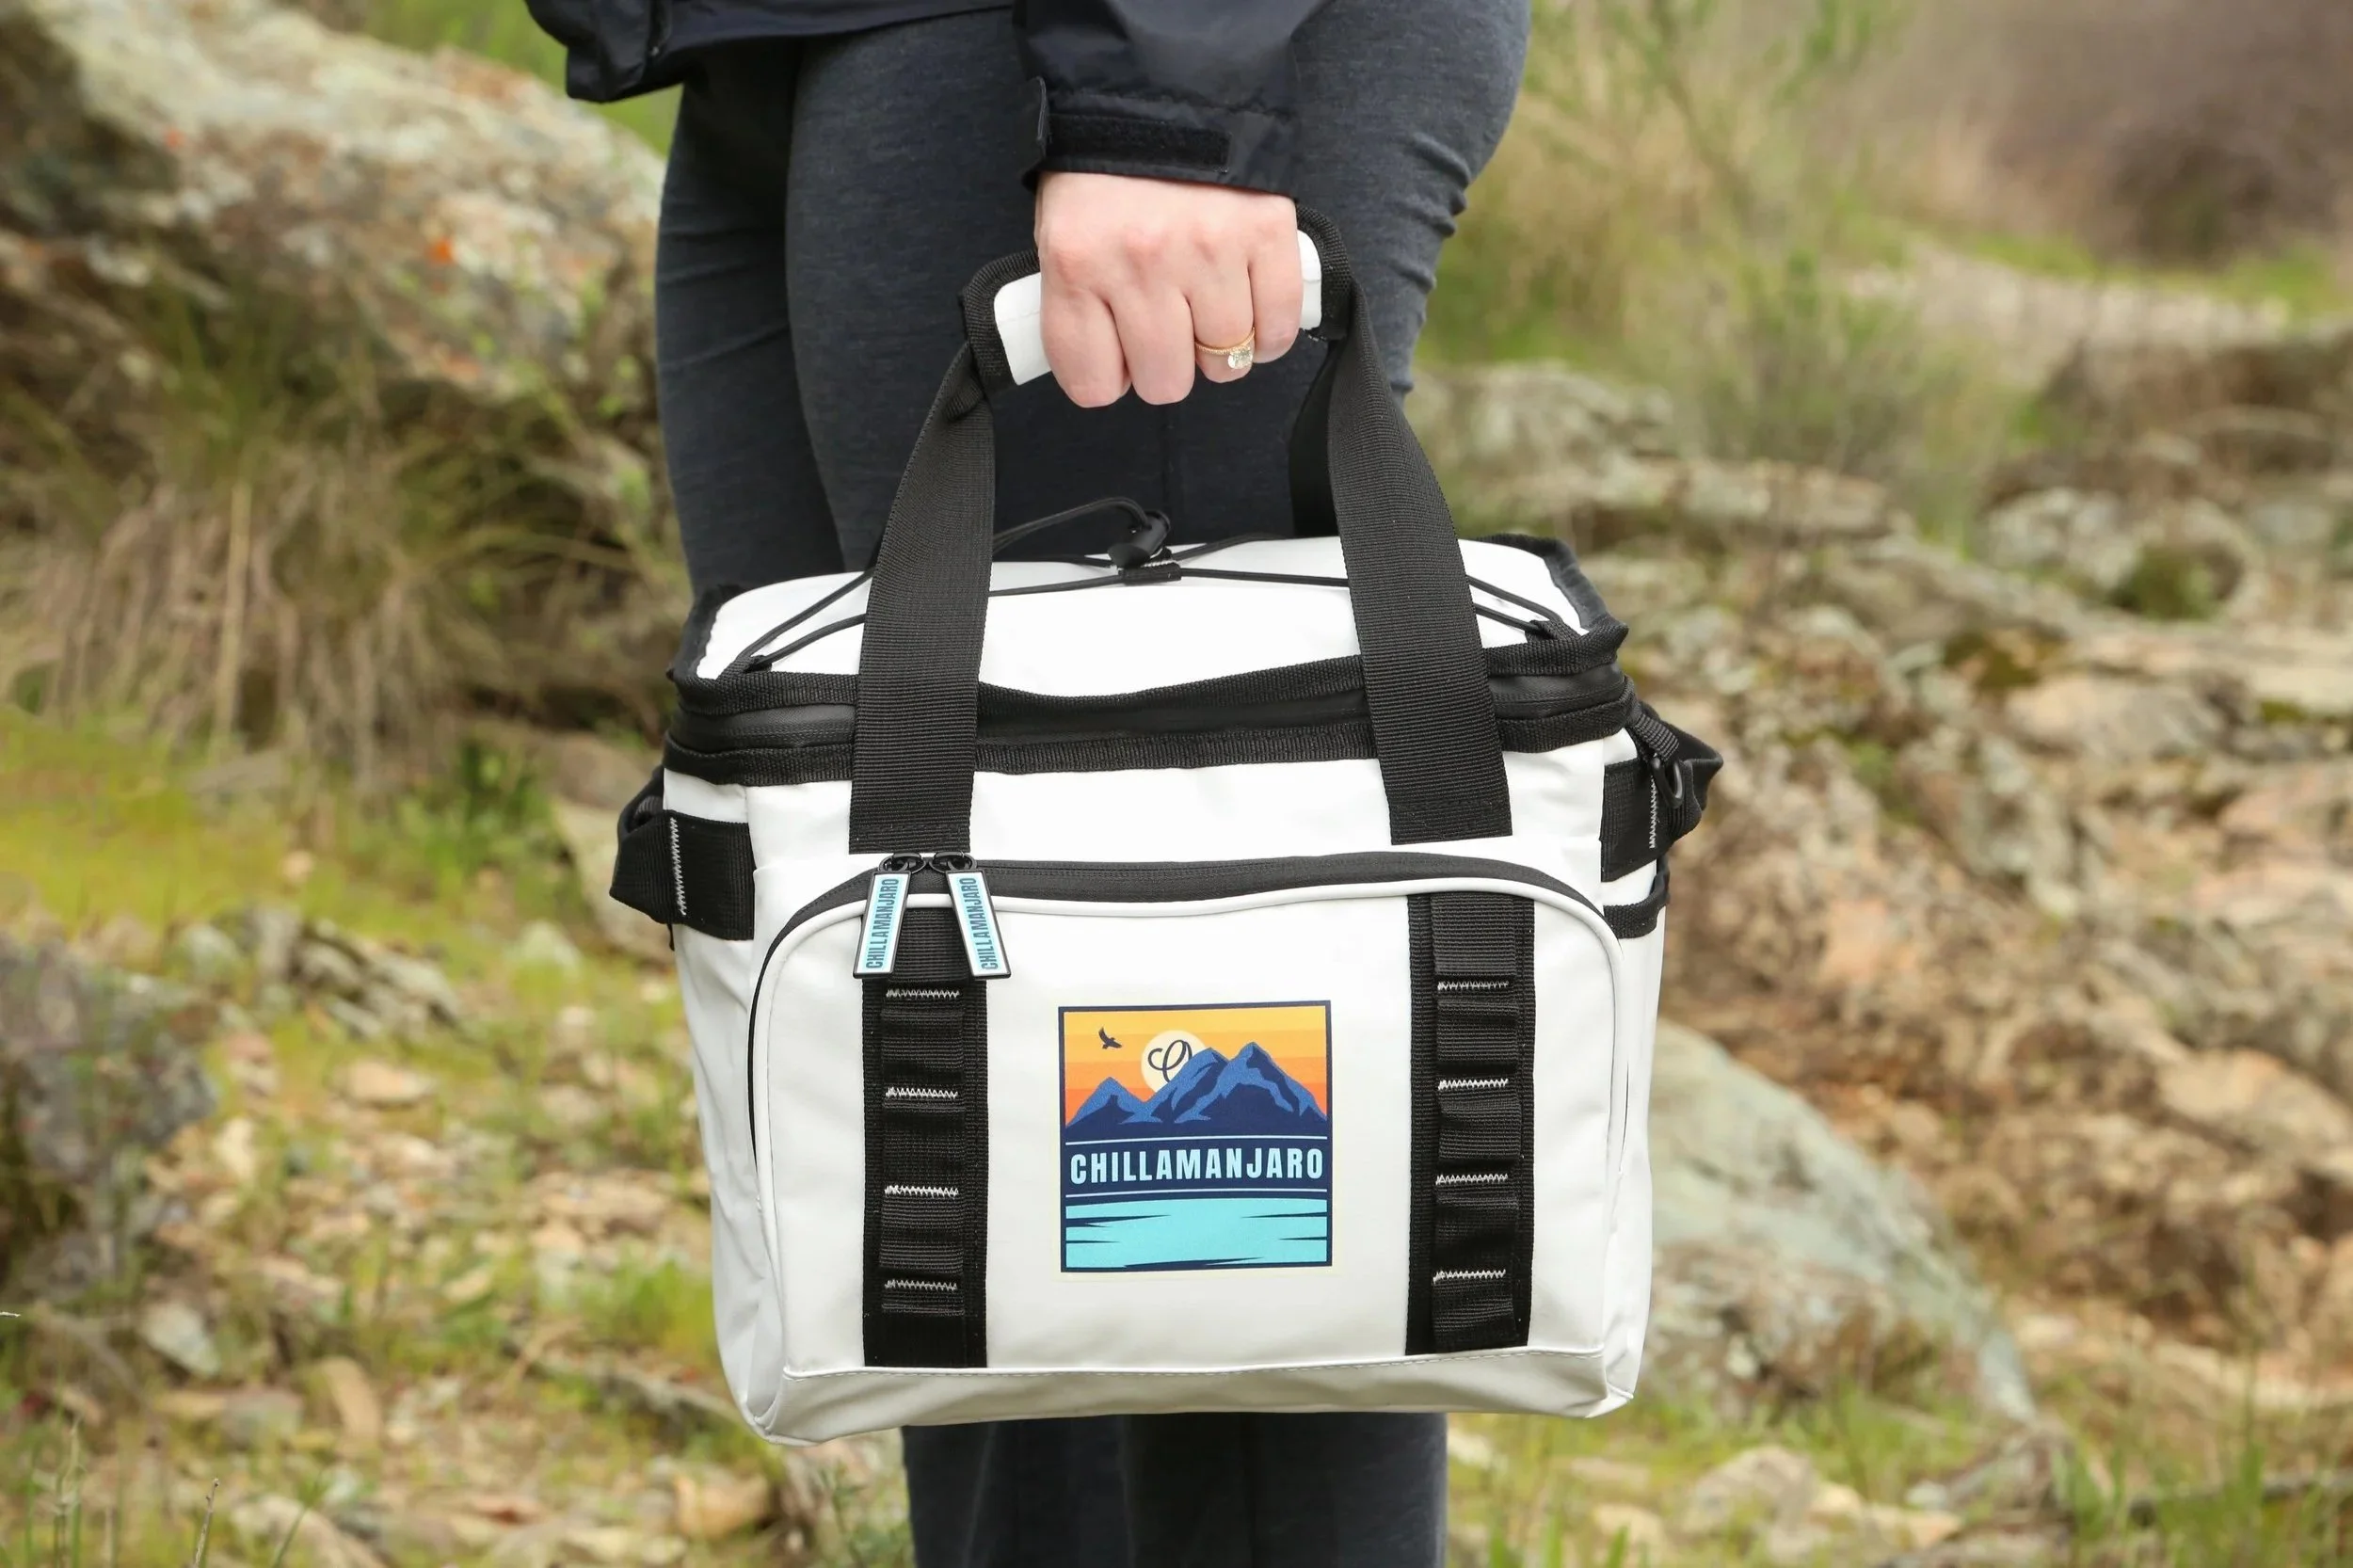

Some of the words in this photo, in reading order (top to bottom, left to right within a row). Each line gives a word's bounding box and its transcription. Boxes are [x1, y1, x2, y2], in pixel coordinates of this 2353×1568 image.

[866, 878, 899, 969] CHILLAMANJARO
[958, 877, 999, 970] CHILLAMANJARO
[1069, 1147, 1323, 1184] CHILLAMANJARO
